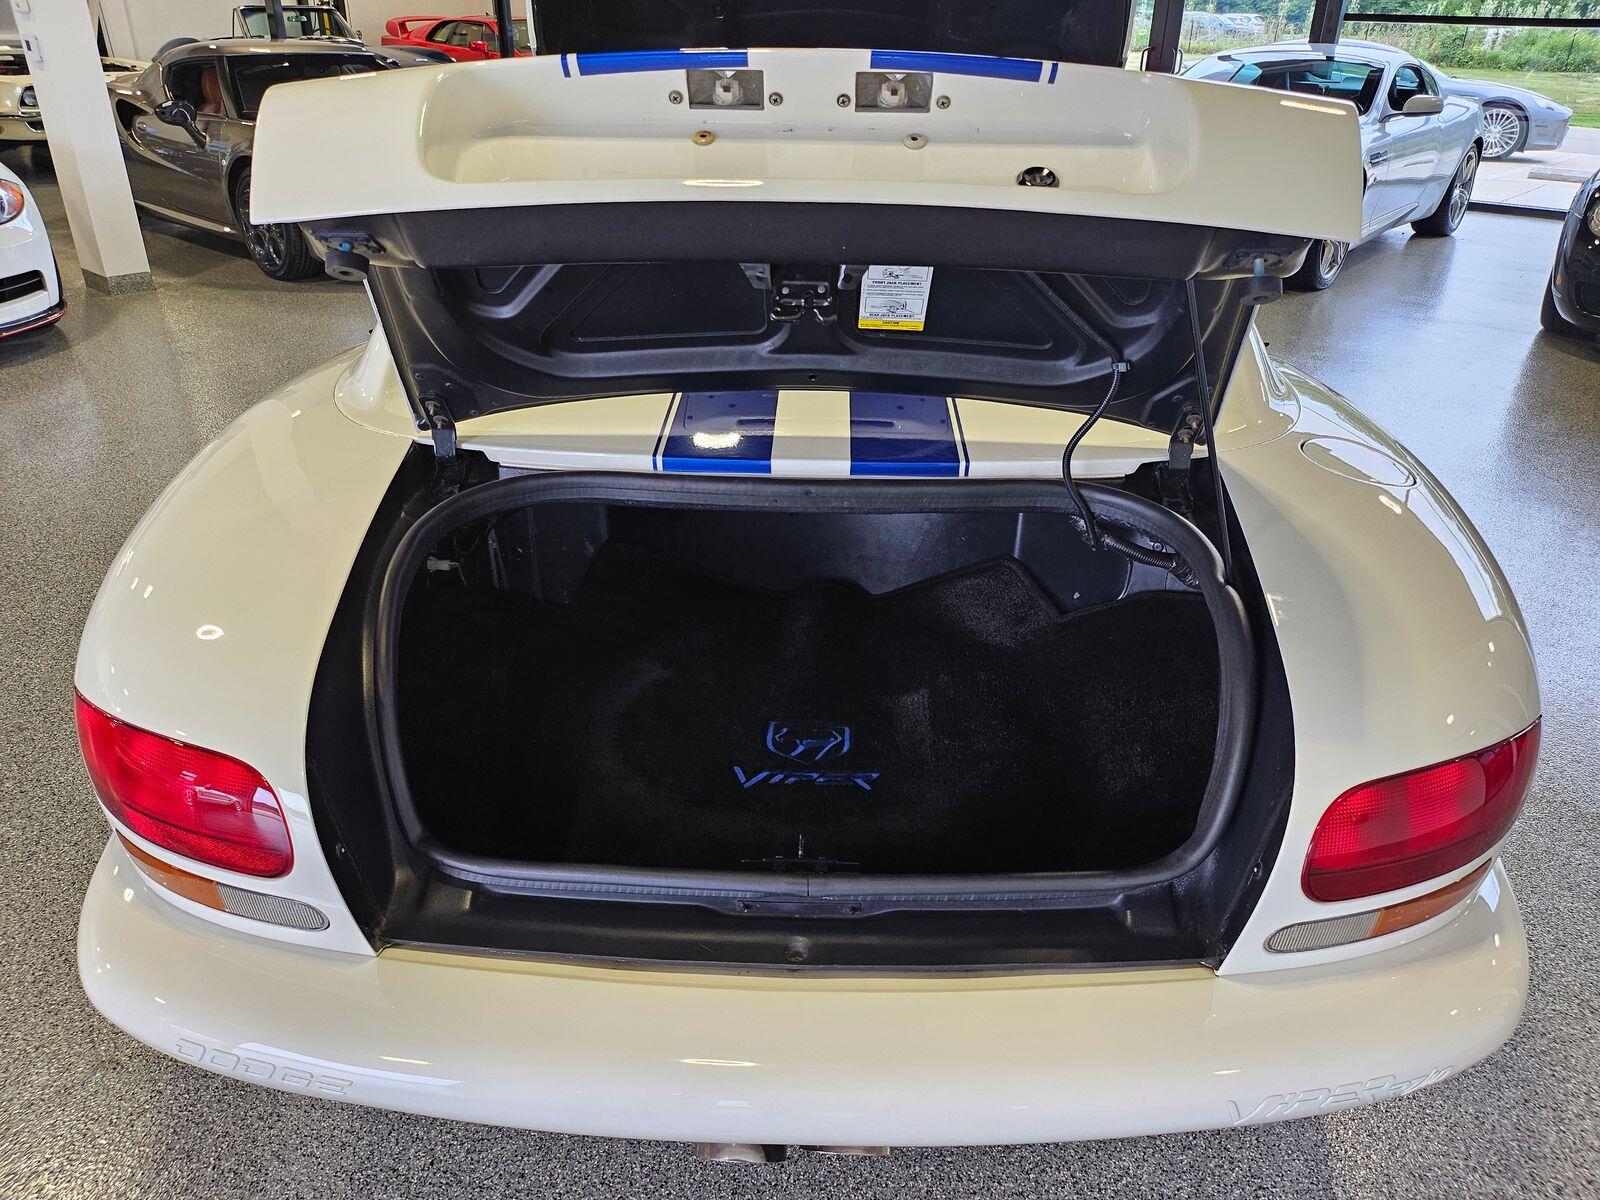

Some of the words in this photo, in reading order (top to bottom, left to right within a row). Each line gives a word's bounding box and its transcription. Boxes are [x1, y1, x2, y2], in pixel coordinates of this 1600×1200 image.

[733, 766, 881, 791] VIPER
[175, 1037, 354, 1096] DODGE
[1225, 1074, 1397, 1126] VIPER
